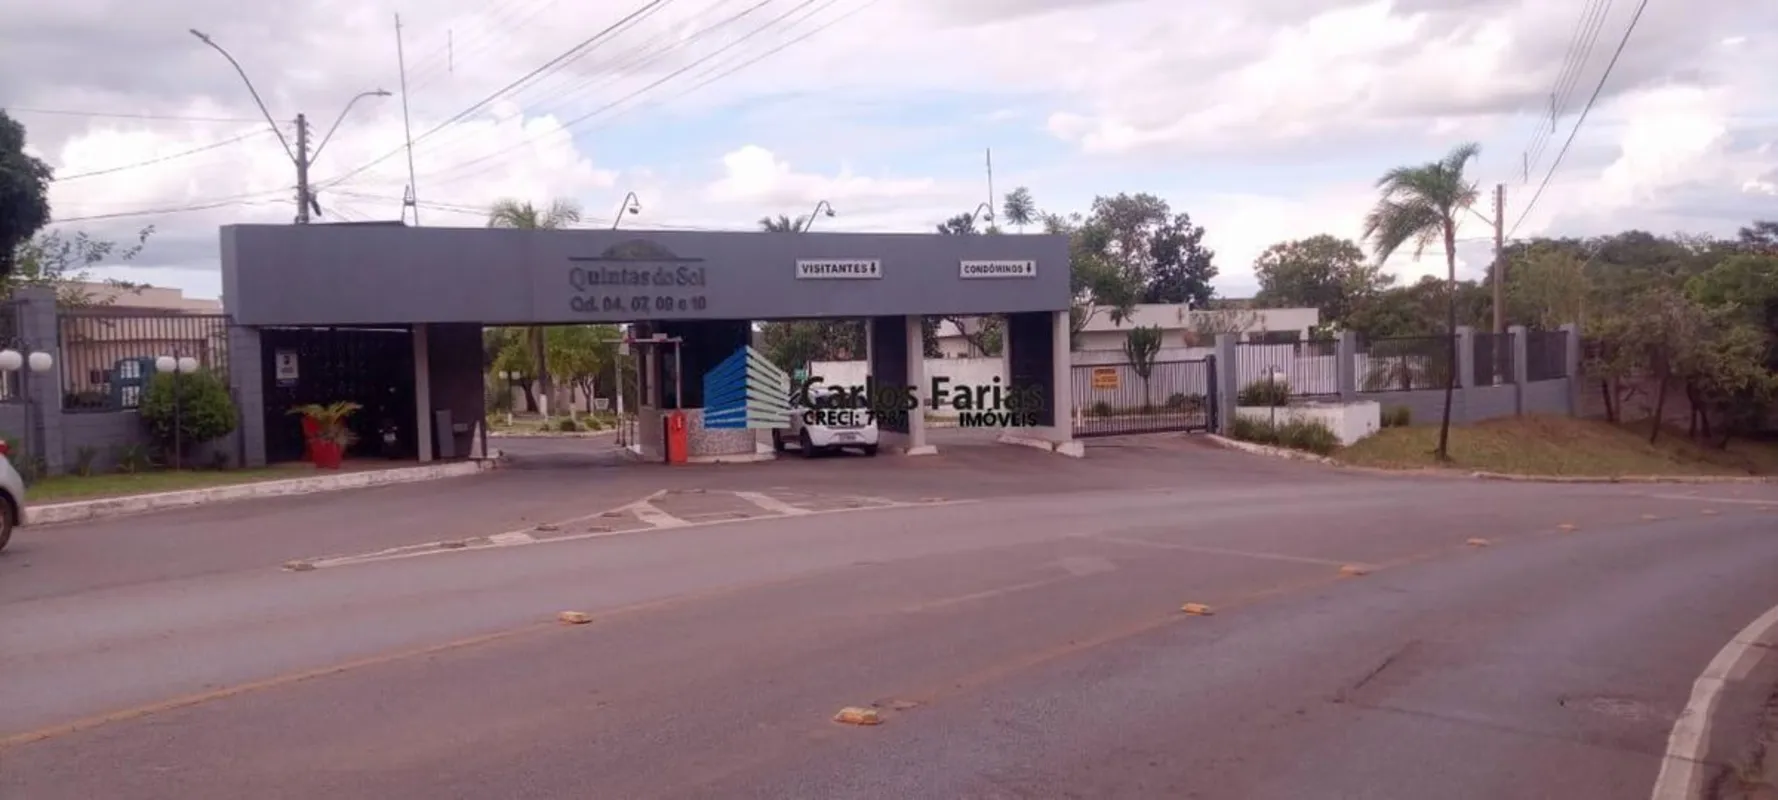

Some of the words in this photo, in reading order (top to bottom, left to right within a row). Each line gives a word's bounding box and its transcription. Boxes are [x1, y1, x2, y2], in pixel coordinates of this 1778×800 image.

[802, 263, 868, 273] VISITANTES
[569, 266, 650, 292] Quintas
[676, 266, 706, 286] Sol
